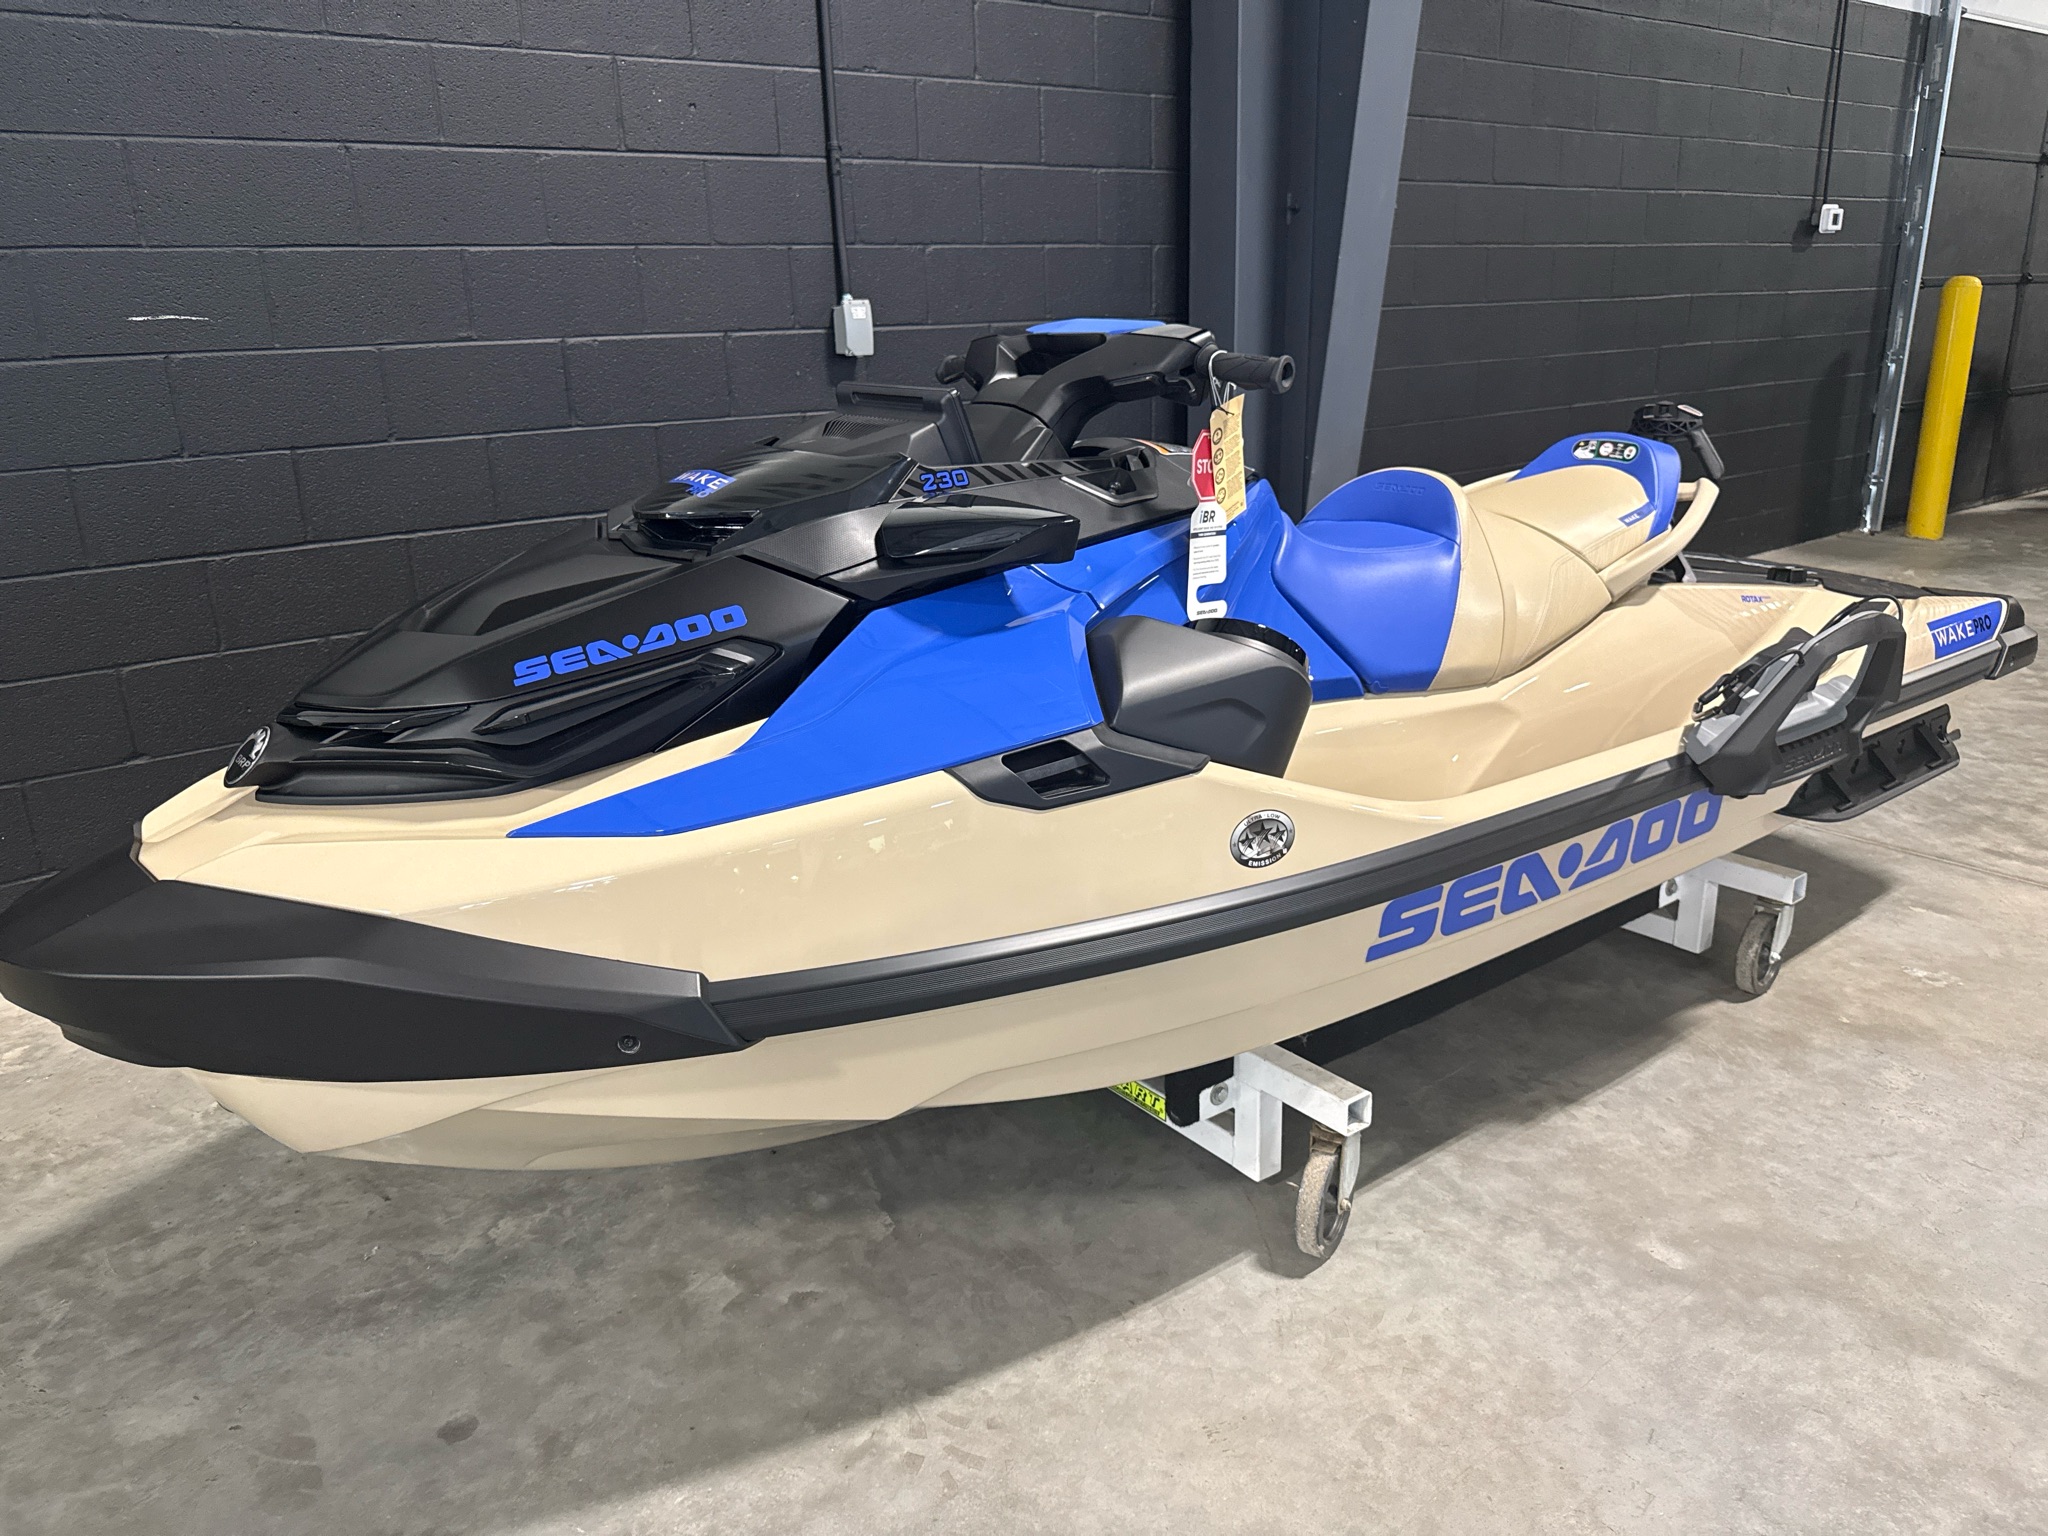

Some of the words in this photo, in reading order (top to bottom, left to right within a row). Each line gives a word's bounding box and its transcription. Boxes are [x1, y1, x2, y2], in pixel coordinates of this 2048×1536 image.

[1196, 458, 1213, 475] STO
[674, 471, 729, 490] WAKE
[920, 468, 969, 492] 230
[1199, 510, 1216, 524] iBR
[1741, 595, 1763, 603] ROTAX
[1244, 814, 1263, 828] ULTRA
[1247, 852, 1282, 867] EMISSION
